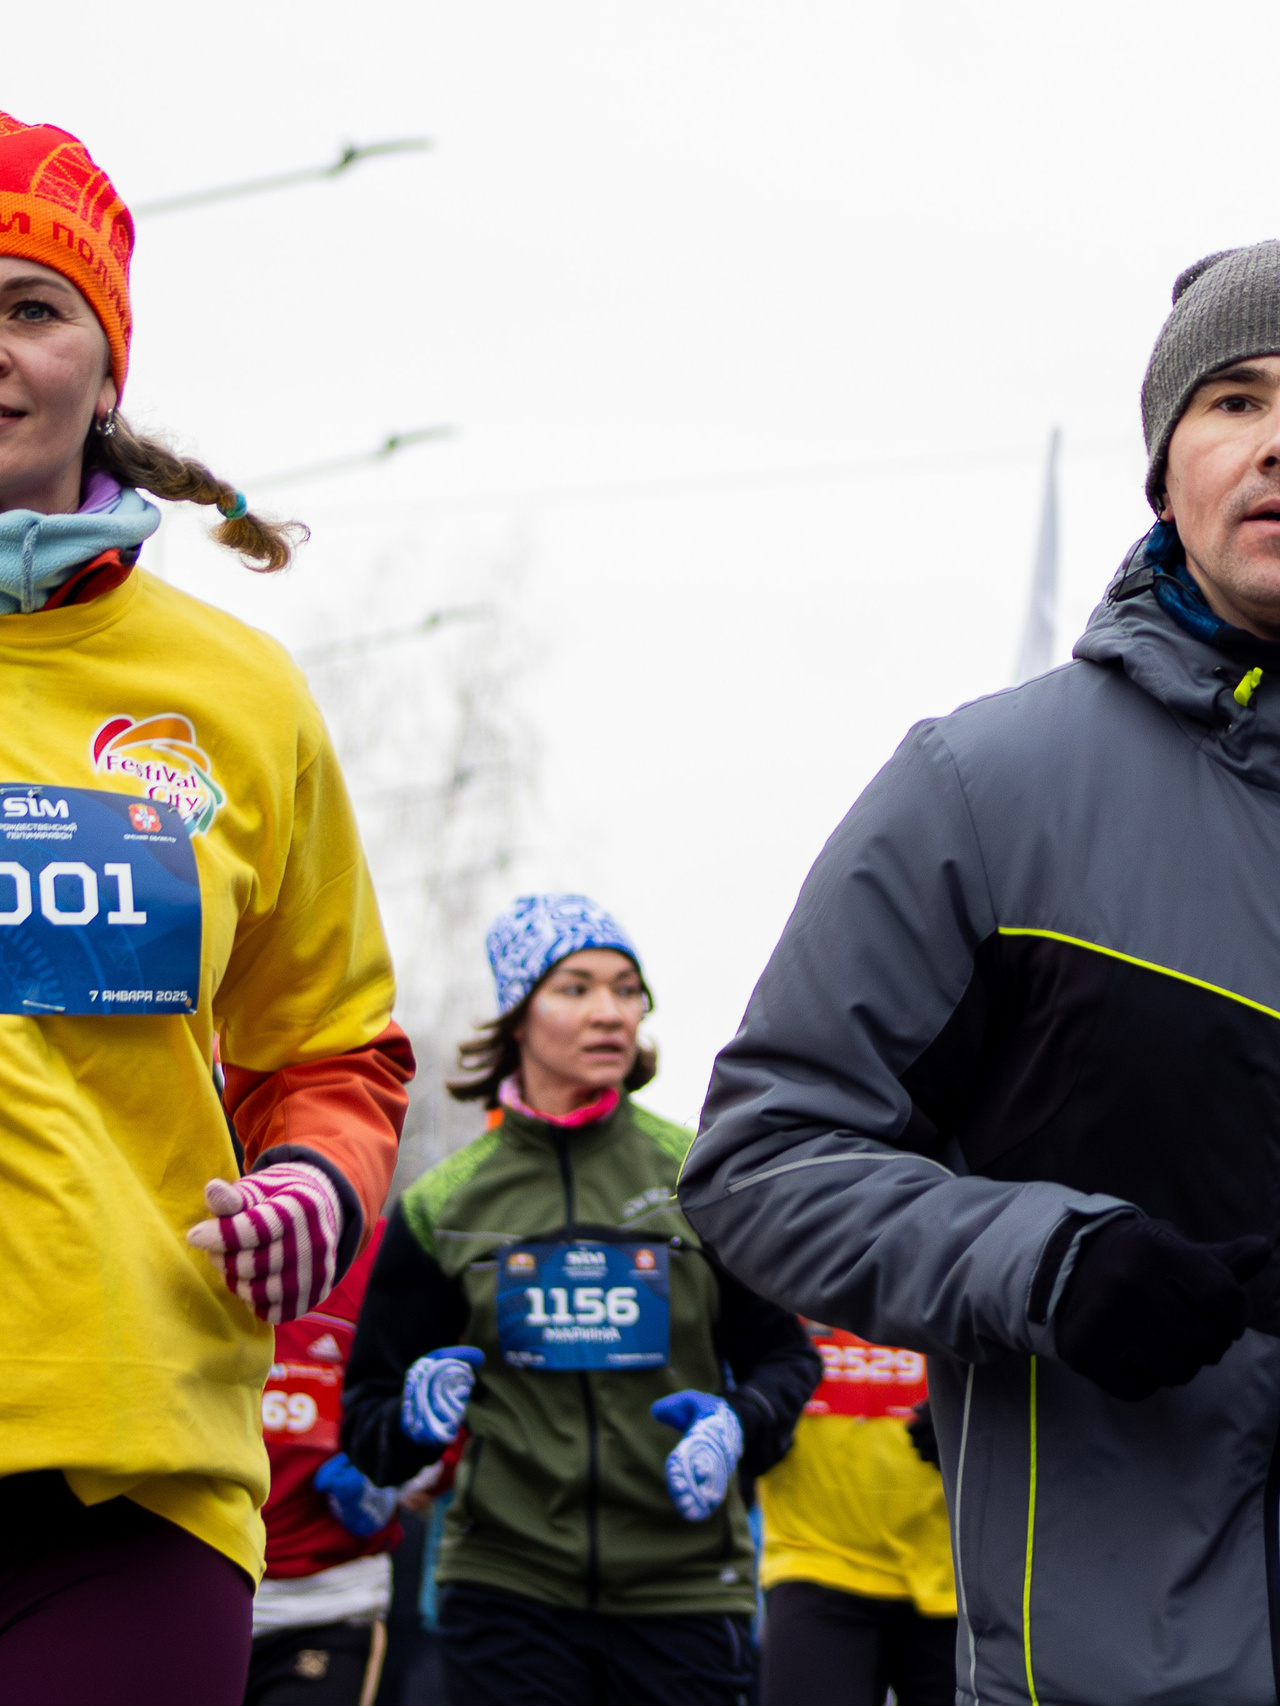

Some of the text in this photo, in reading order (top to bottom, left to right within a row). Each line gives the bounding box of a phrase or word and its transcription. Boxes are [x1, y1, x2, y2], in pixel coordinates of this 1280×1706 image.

[89, 990, 99, 1003] 7
[155, 990, 188, 1002] 2025
[525, 1286, 640, 1327] 1156
